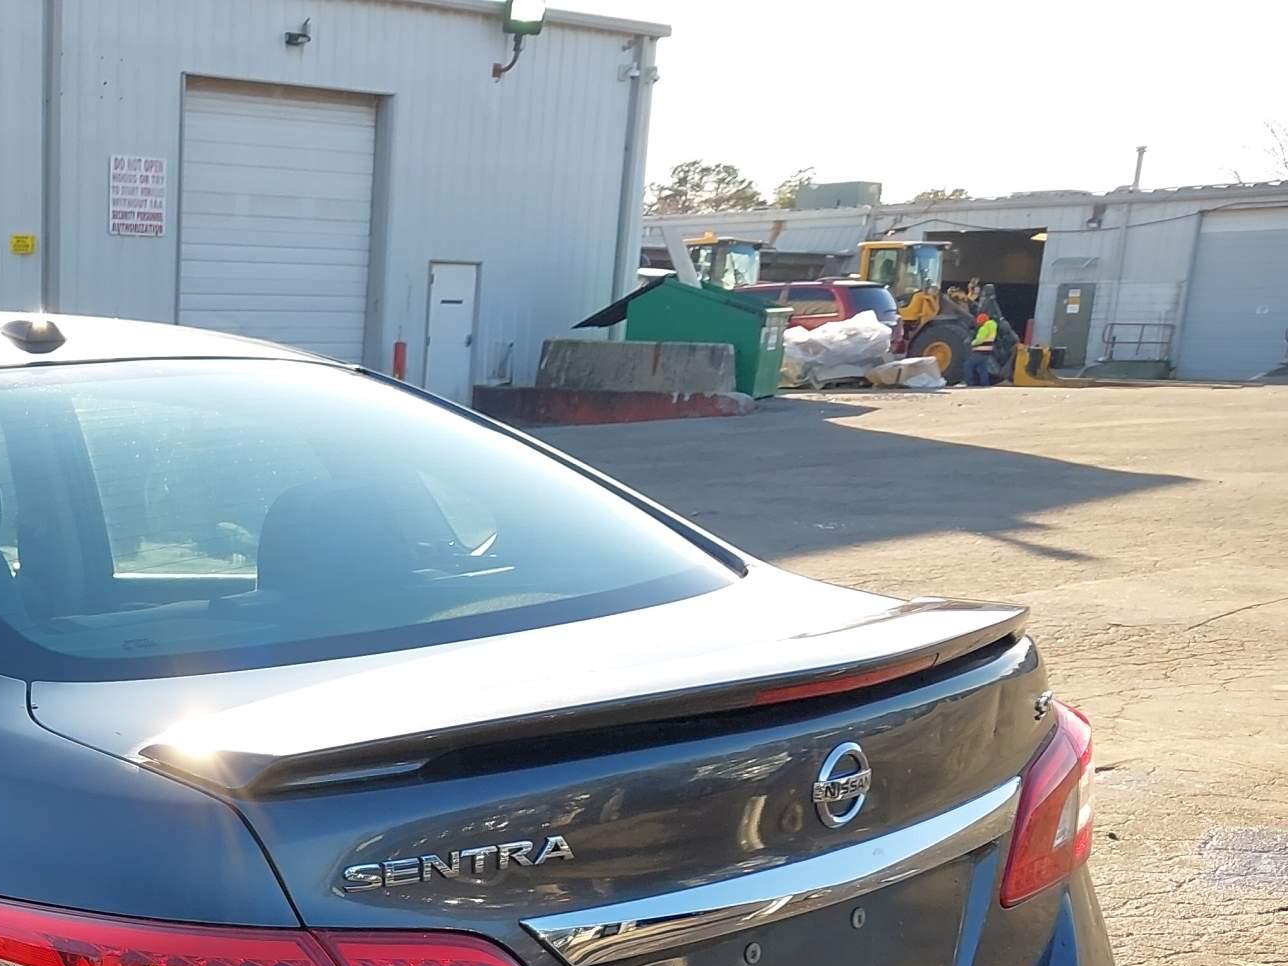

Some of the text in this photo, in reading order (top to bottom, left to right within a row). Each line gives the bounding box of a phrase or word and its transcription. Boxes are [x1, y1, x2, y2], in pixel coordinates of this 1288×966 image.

[114, 157, 163, 173] DO NOT OPEN
[139, 174, 149, 184] OR
[823, 774, 870, 799] NISSAN
[343, 835, 575, 893] SENTRA
